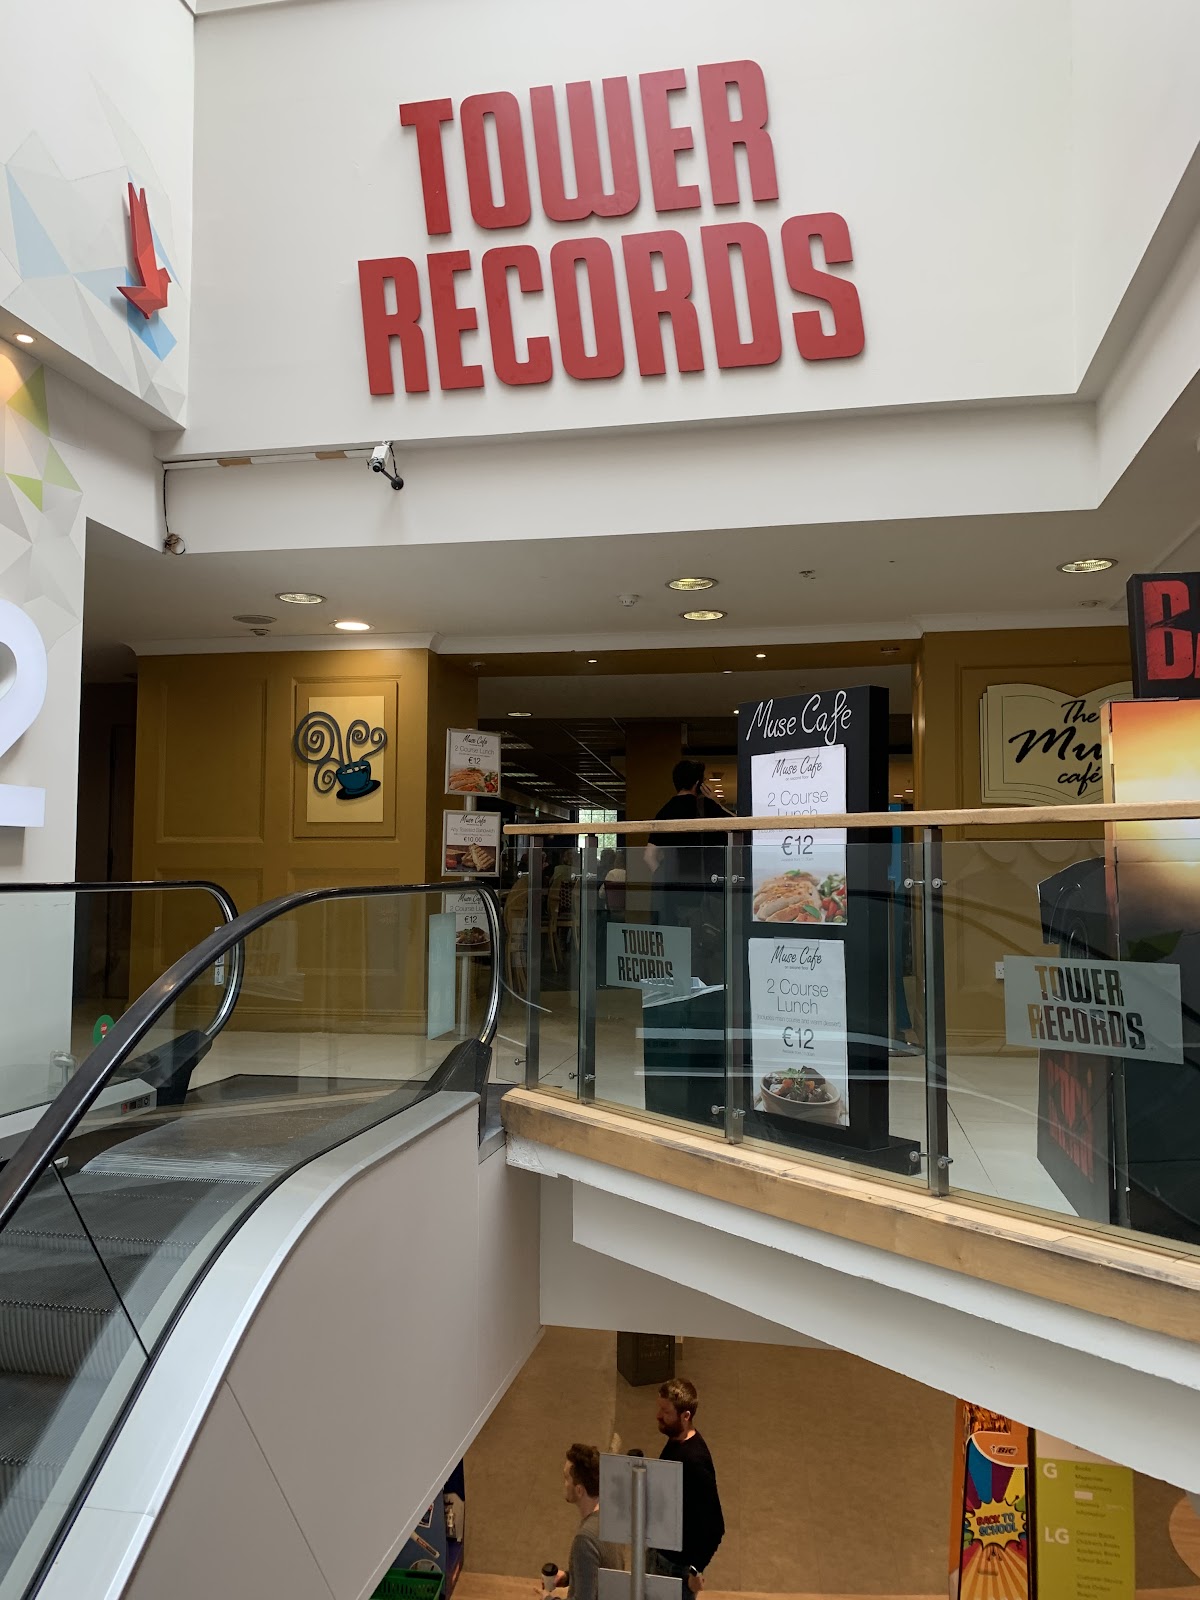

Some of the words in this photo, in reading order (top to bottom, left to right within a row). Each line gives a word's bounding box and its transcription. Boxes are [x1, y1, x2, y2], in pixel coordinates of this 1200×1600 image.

[399, 60, 779, 235] TOWER
[358, 212, 865, 396] RECORDS
[1142, 580, 1200, 680] B
[746, 699, 797, 741] Muse
[801, 690, 852, 746] Cafe
[1061, 699, 1100, 724] The
[480, 748, 495, 756] Lunch
[1008, 726, 1102, 764] Mu
[468, 756, 481, 765] €12
[771, 758, 798, 778] Muse
[800, 754, 823, 779] Cafe
[1057, 762, 1102, 796] café
[767, 792, 776, 807] 2
[780, 790, 829, 806] Course
[781, 835, 814, 856] €12
[472, 893, 482, 905] Caf
[464, 915, 478, 923] €12
[621, 929, 665, 957] TOWER
[771, 945, 797, 964] Muse
[799, 946, 823, 970] Cafe
[617, 956, 675, 987] RECORDS
[767, 978, 775, 994] 2
[779, 979, 829, 997] Course
[1035, 965, 1124, 1007] TOWER
[777, 996, 819, 1015] Lunch
[782, 1026, 815, 1049] €12
[1027, 1004, 1146, 1050] RECORDS
[1043, 1463, 1058, 1479] G
[976, 1514, 1001, 1526] BACK
[1001, 1512, 1015, 1523] TO
[979, 1522, 1019, 1536] SCHOOL
[1044, 1527, 1070, 1544] LG
